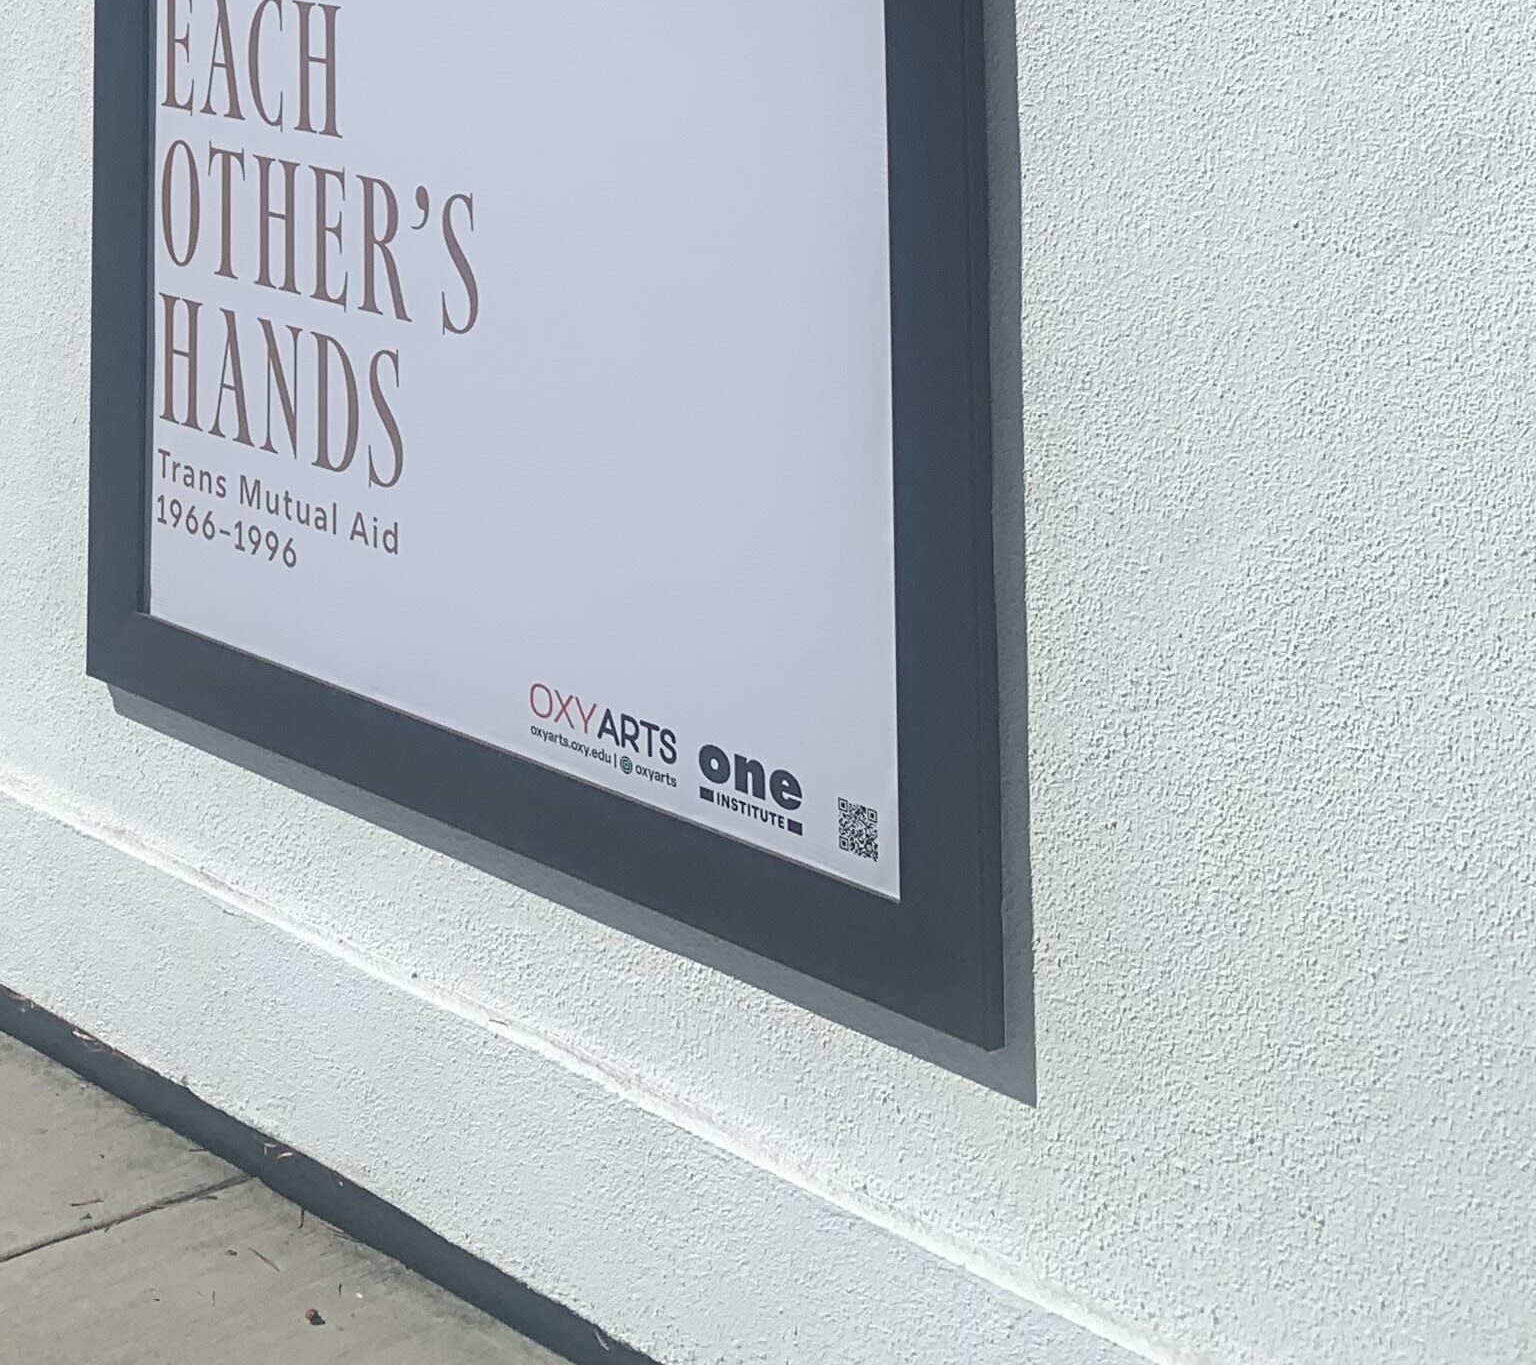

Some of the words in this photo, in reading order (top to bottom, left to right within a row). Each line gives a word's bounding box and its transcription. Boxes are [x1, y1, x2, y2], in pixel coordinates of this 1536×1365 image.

[161, 140, 479, 335] OTHER’S
[159, 292, 404, 489] HANDS
[157, 448, 227, 499] Trans
[239, 474, 337, 535] Mutual
[349, 511, 399, 556] Aid
[529, 683, 678, 765] OXYARTS
[530, 725, 612, 765] oxyarts.oxy.edu
[635, 764, 678, 788] oxyarts
[699, 744, 803, 810] one
[716, 792, 786, 830] INSTITUTE
